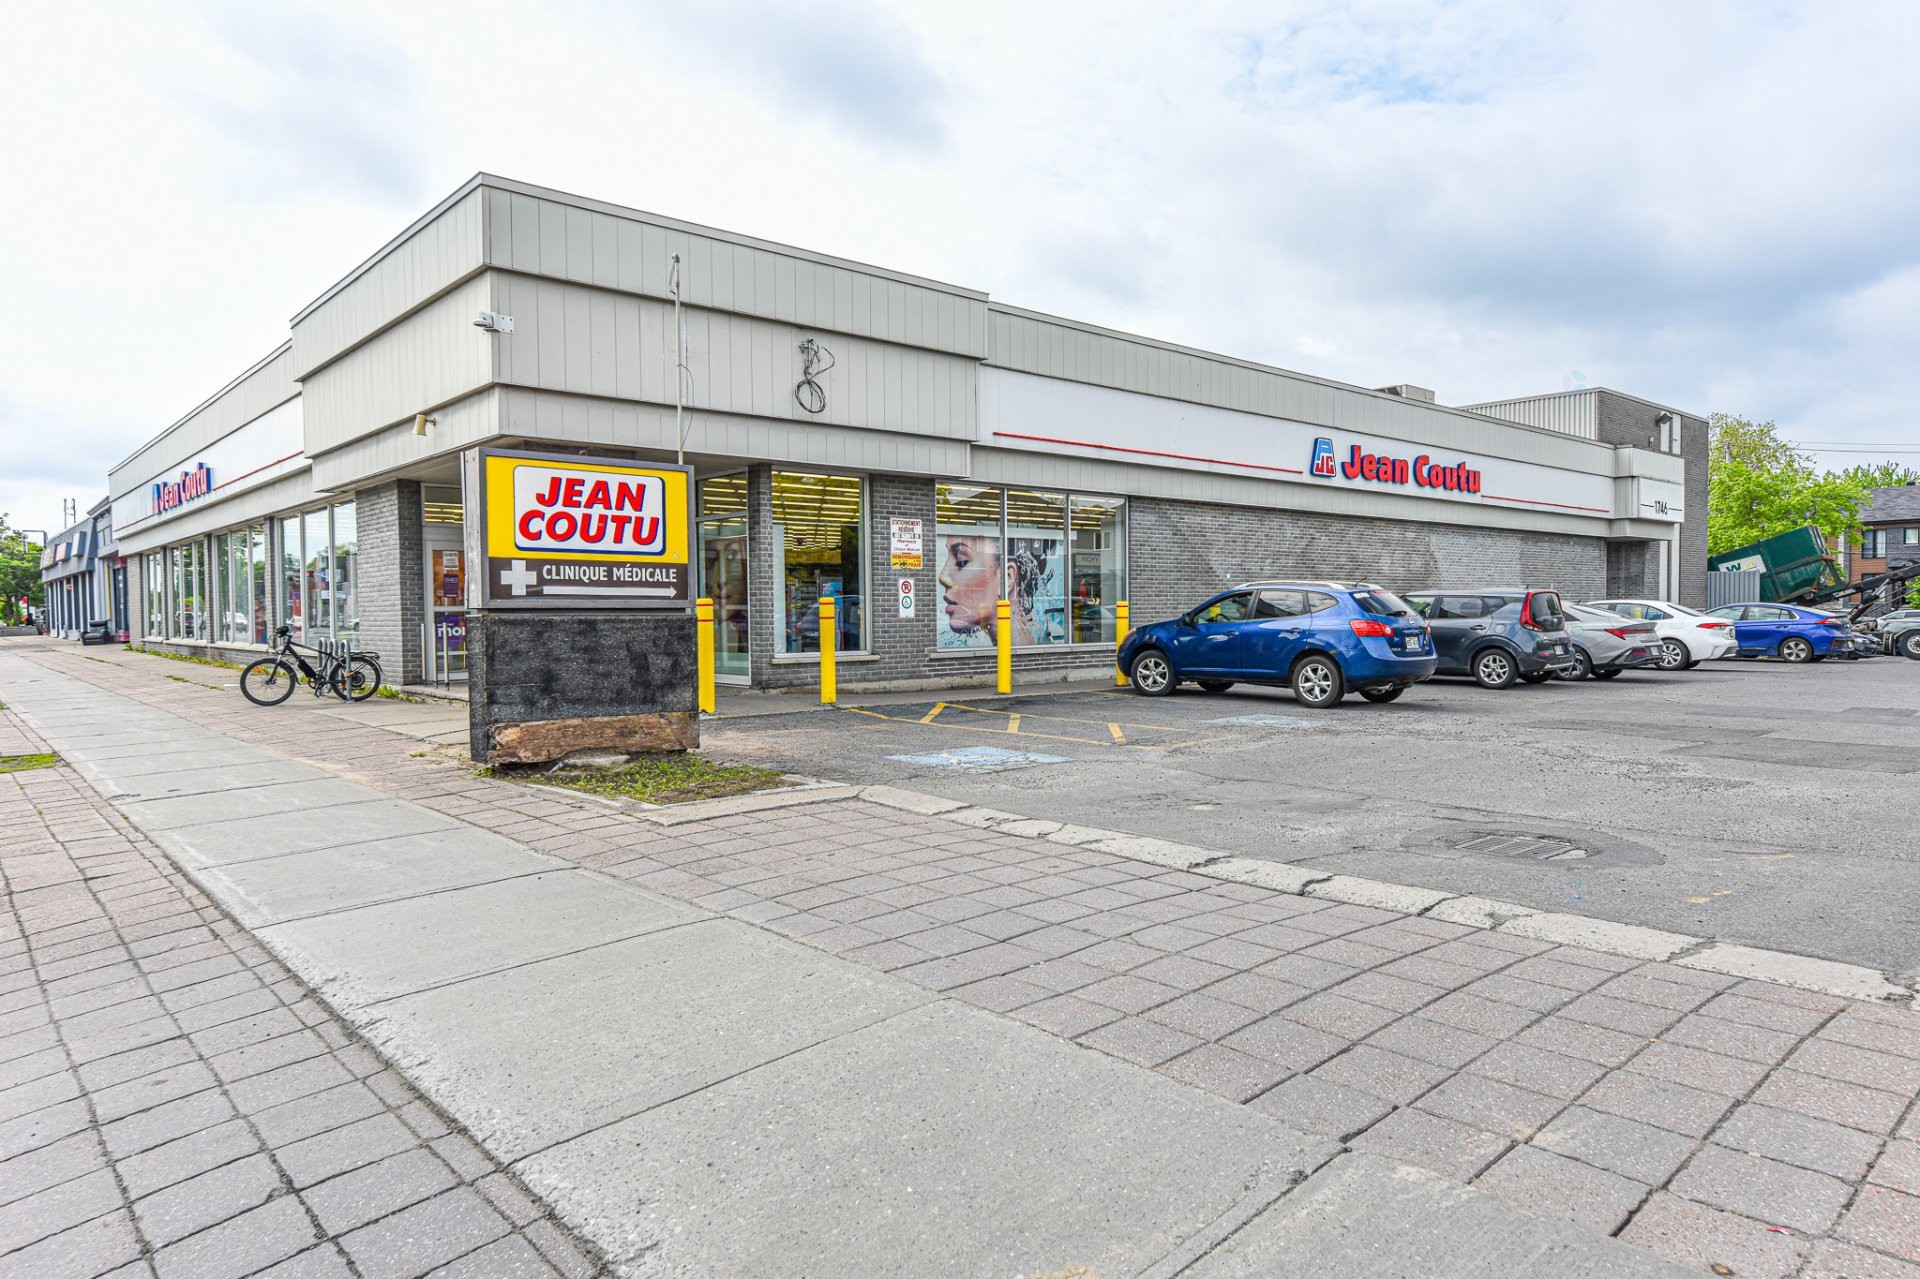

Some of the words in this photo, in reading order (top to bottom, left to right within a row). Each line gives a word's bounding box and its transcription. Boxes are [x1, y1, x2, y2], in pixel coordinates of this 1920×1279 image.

[1315, 455, 1335, 474] JC
[1341, 444, 1409, 484] Jean
[1413, 454, 1481, 493] Coutu
[159, 481, 182, 513] Jean
[179, 461, 212, 502] Coutu
[535, 476, 646, 512] JEAN
[1654, 500, 1668, 516] 1746
[518, 509, 660, 546] COUTU
[542, 564, 608, 583] CLINIQUE
[613, 563, 677, 583] MÉDICALE
